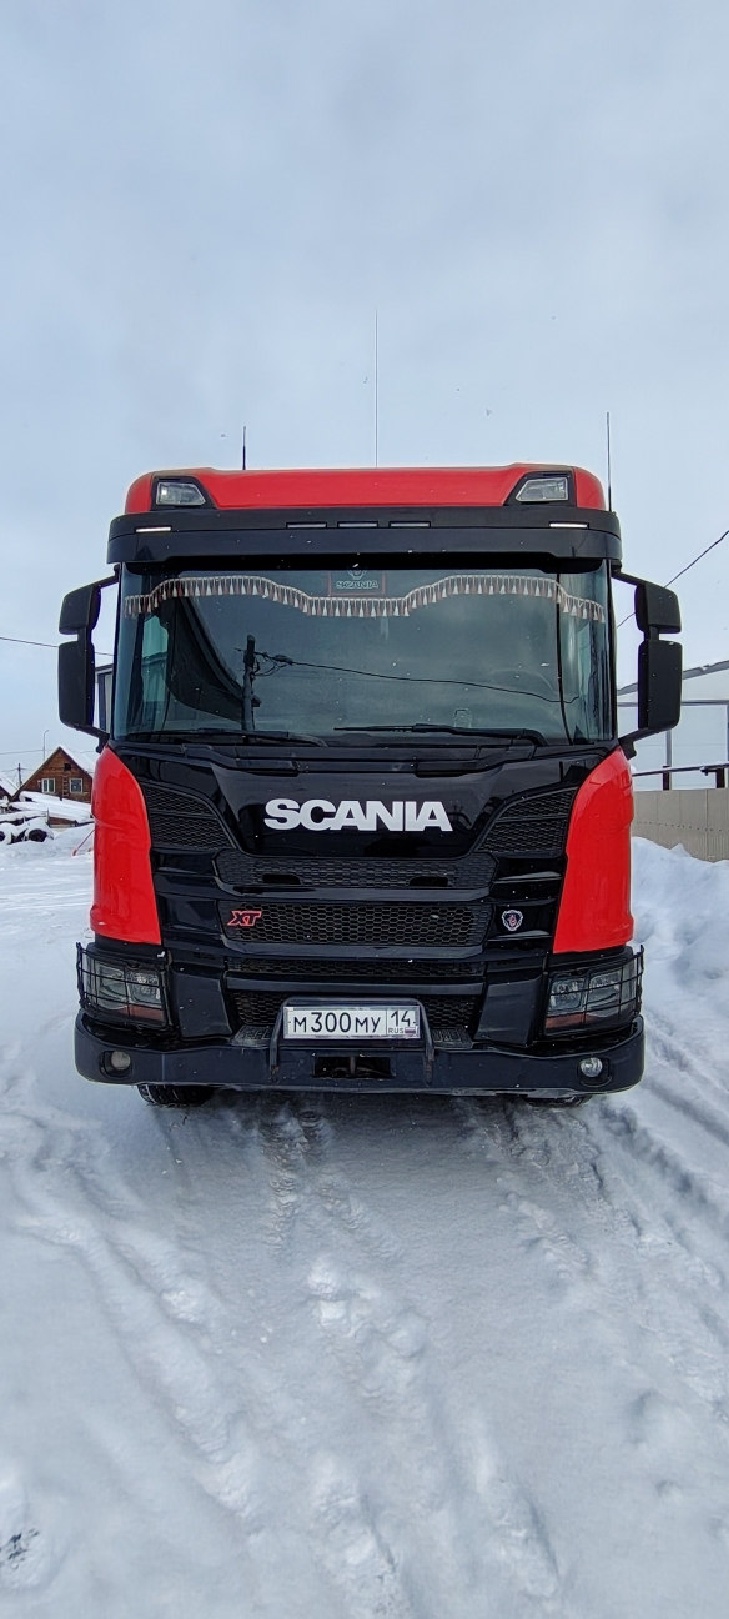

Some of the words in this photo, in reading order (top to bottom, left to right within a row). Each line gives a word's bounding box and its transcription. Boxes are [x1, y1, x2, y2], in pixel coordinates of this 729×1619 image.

[264, 798, 453, 832] SCANIA
[227, 910, 262, 926] XT
[390, 1010, 411, 1027] 14
